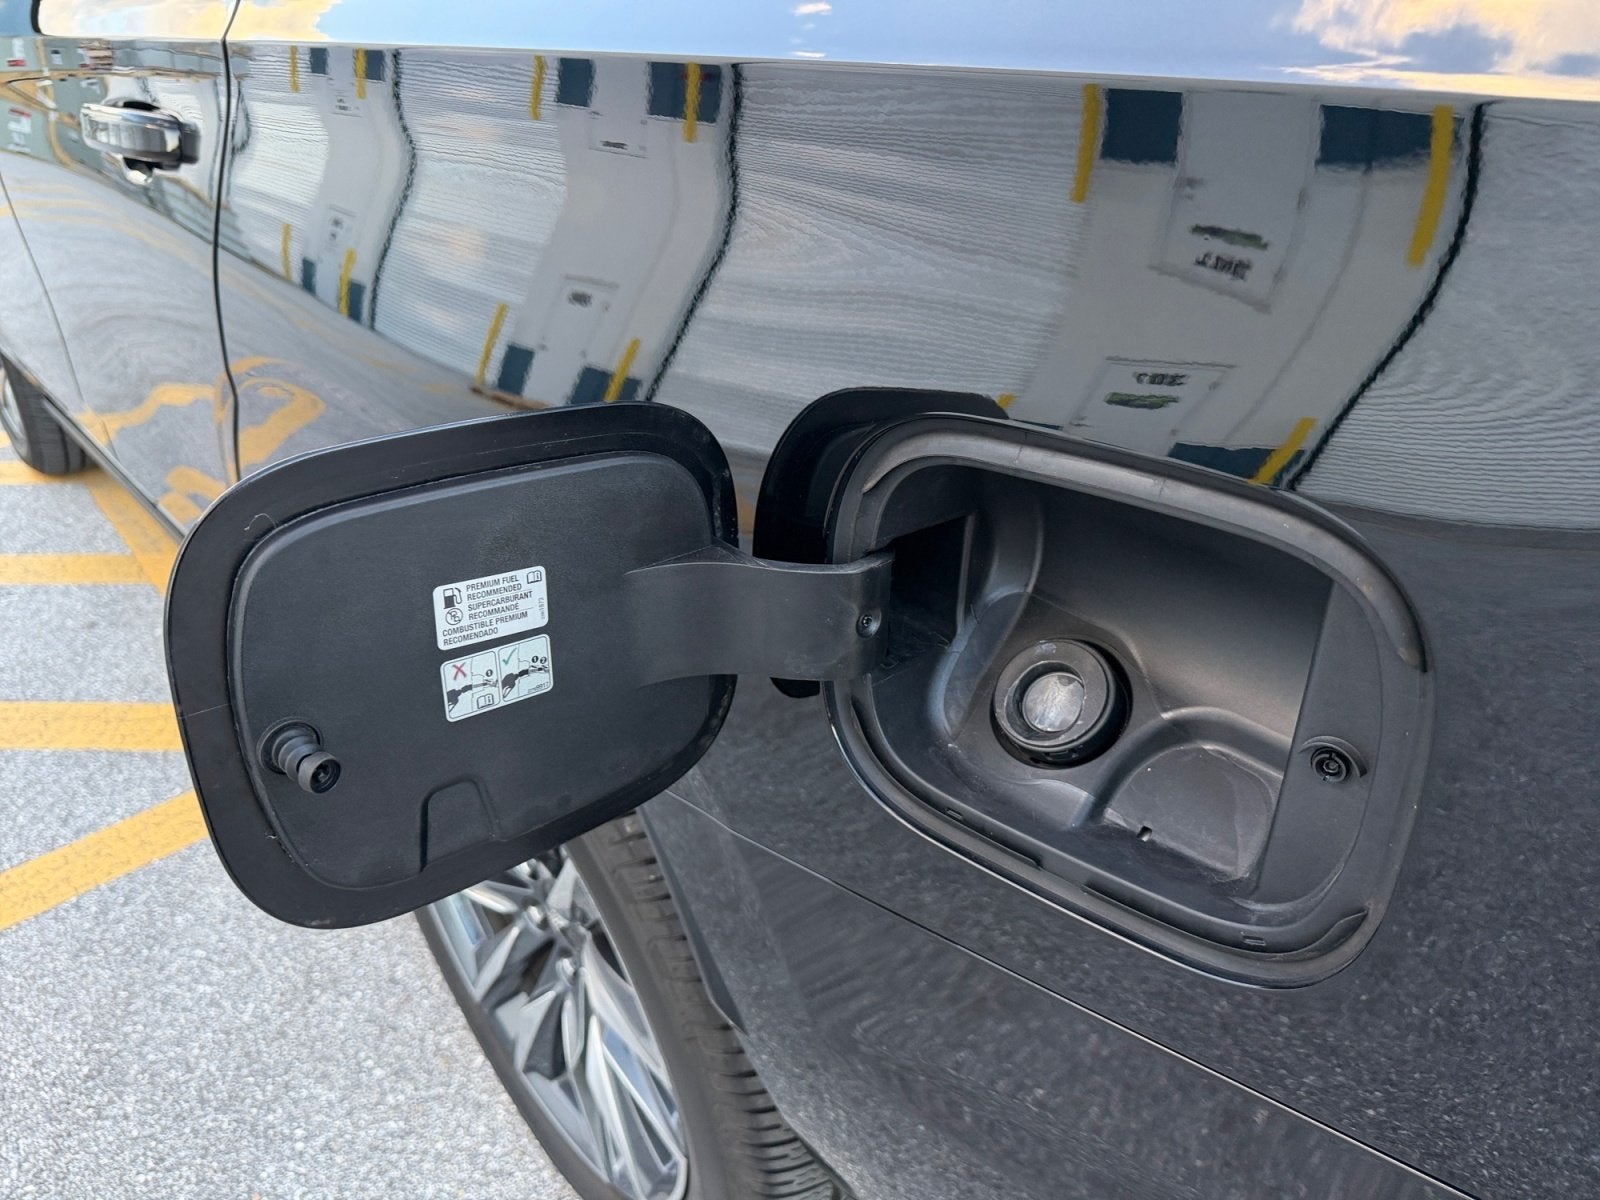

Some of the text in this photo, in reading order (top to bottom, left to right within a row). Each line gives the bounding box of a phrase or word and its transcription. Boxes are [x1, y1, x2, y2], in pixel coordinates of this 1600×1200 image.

[466, 574, 519, 592] PREMIUM FUEL
[467, 583, 522, 601] RECOMMENDED
[468, 591, 533, 611] SUPERCARBURANT
[442, 611, 528, 637] COMBUSTIBLE PREMIUM
[443, 627, 499, 646] RECOMENDADO
